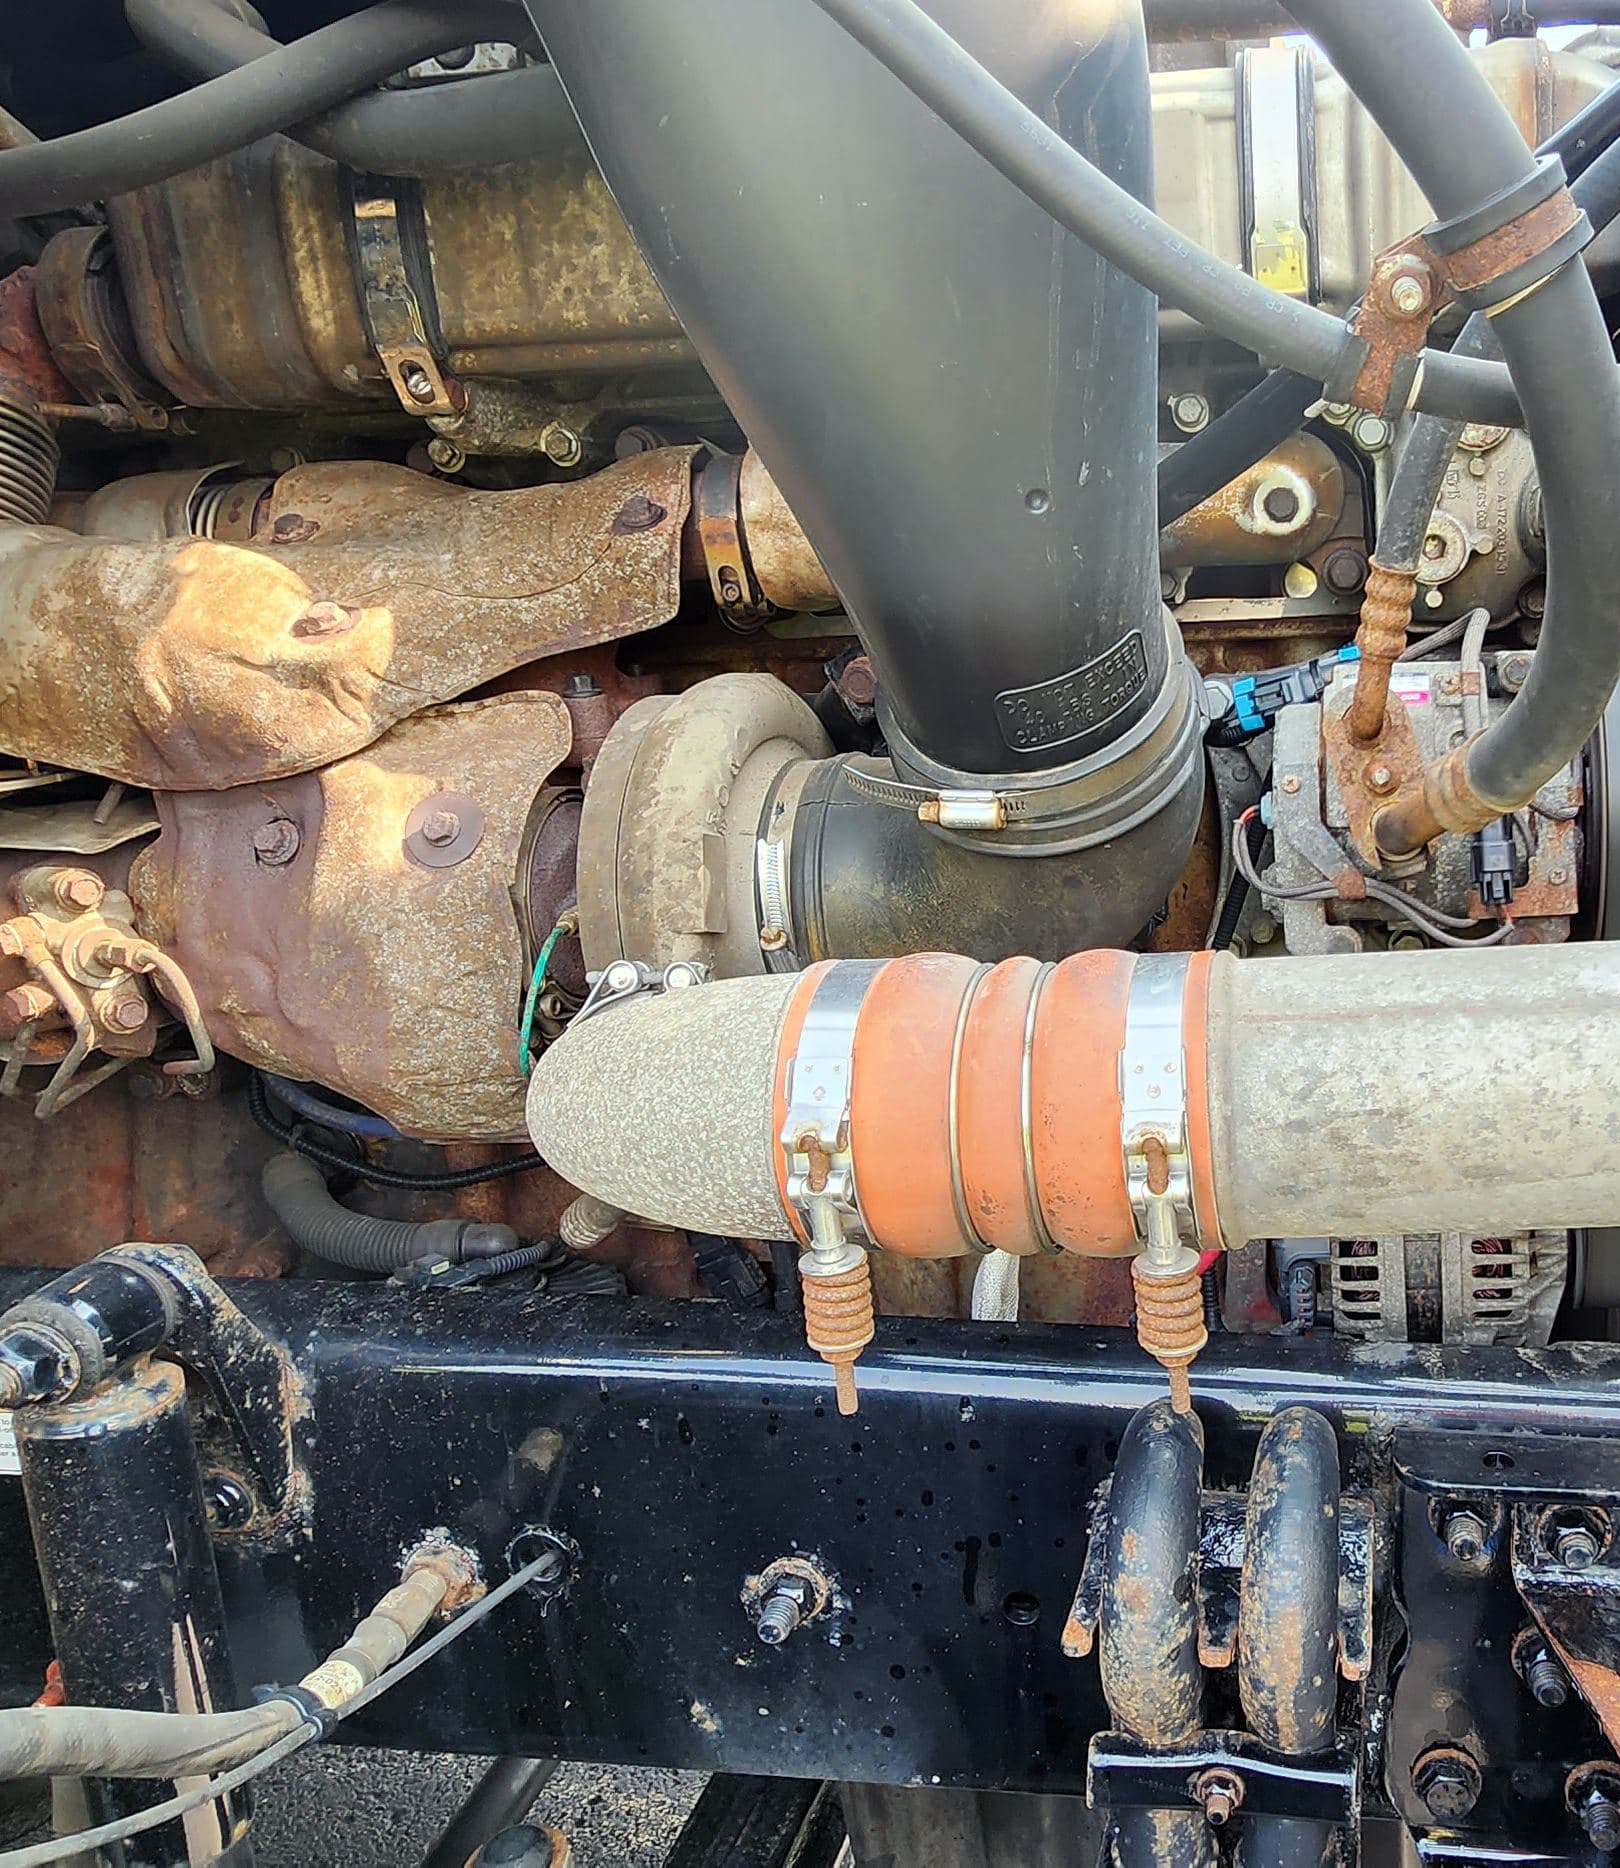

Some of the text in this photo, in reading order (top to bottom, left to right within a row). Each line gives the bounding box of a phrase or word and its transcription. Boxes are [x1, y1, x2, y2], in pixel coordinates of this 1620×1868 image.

[1003, 699, 1028, 714] DO
[1084, 639, 1138, 688] EXCEED
[1016, 668, 1146, 745] CLAMPING TORQUE
